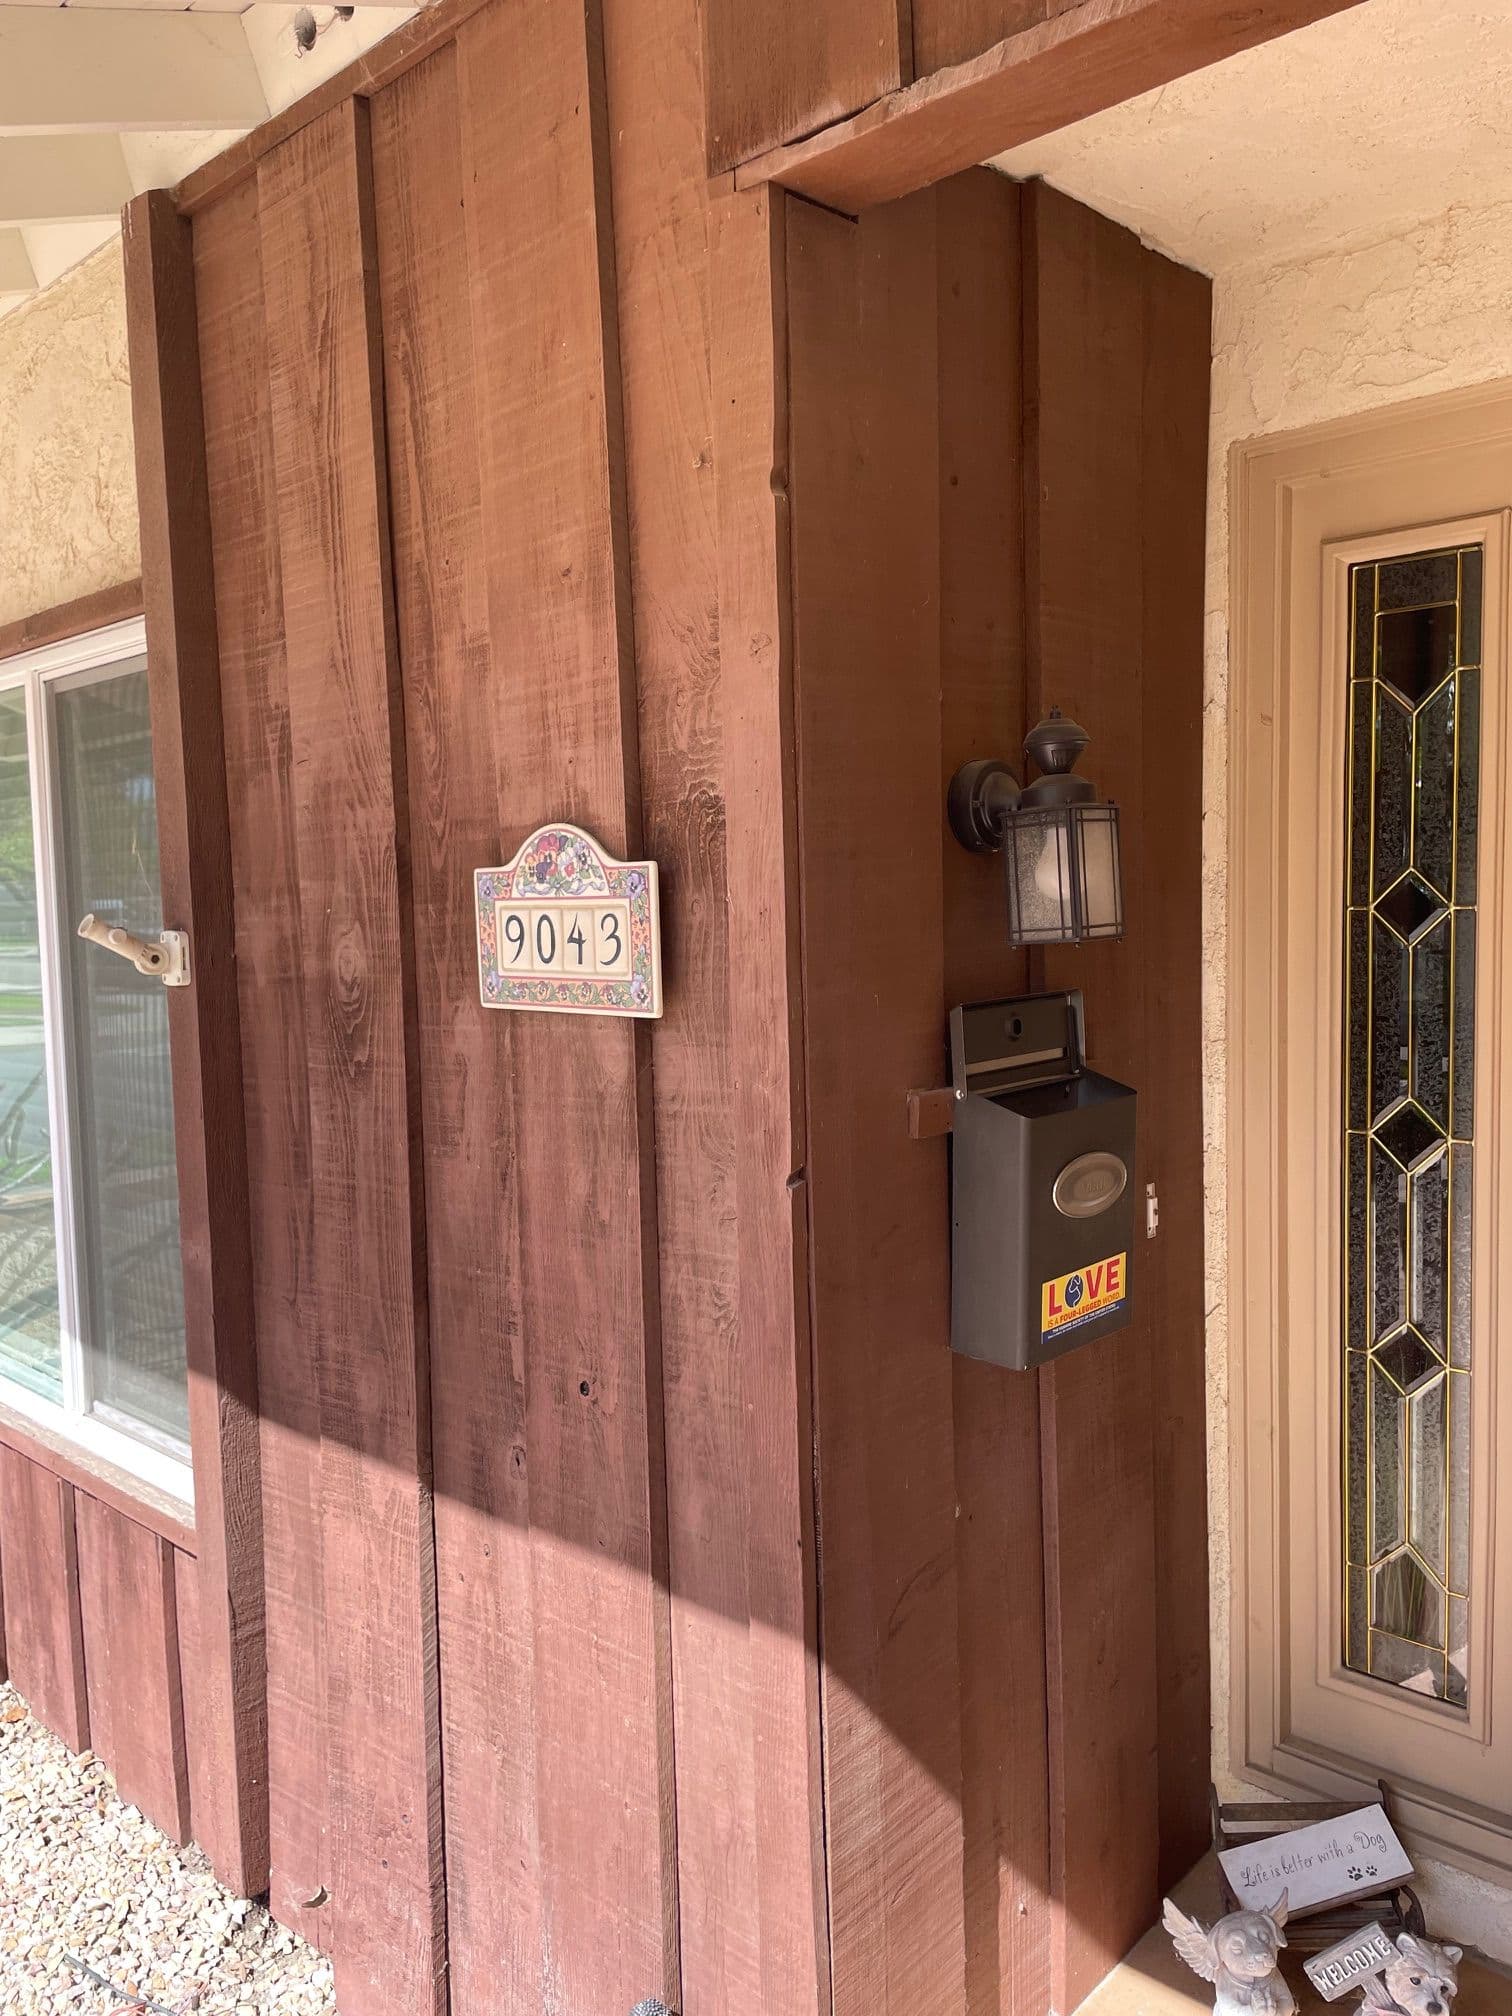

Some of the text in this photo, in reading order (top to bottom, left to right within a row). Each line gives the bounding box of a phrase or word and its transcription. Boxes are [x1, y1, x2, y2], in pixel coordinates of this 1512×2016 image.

[505, 912, 622, 966] 9043
[1060, 1299, 1102, 1323] FOUR-LEGGED
[1240, 1864, 1270, 1887] Life
[1270, 1865, 1281, 1877] is
[1316, 1839, 1344, 1864] with
[1346, 1844, 1354, 1854] a
[1353, 1831, 1387, 1853] Dog
[1313, 1936, 1391, 1991] WELCOME
